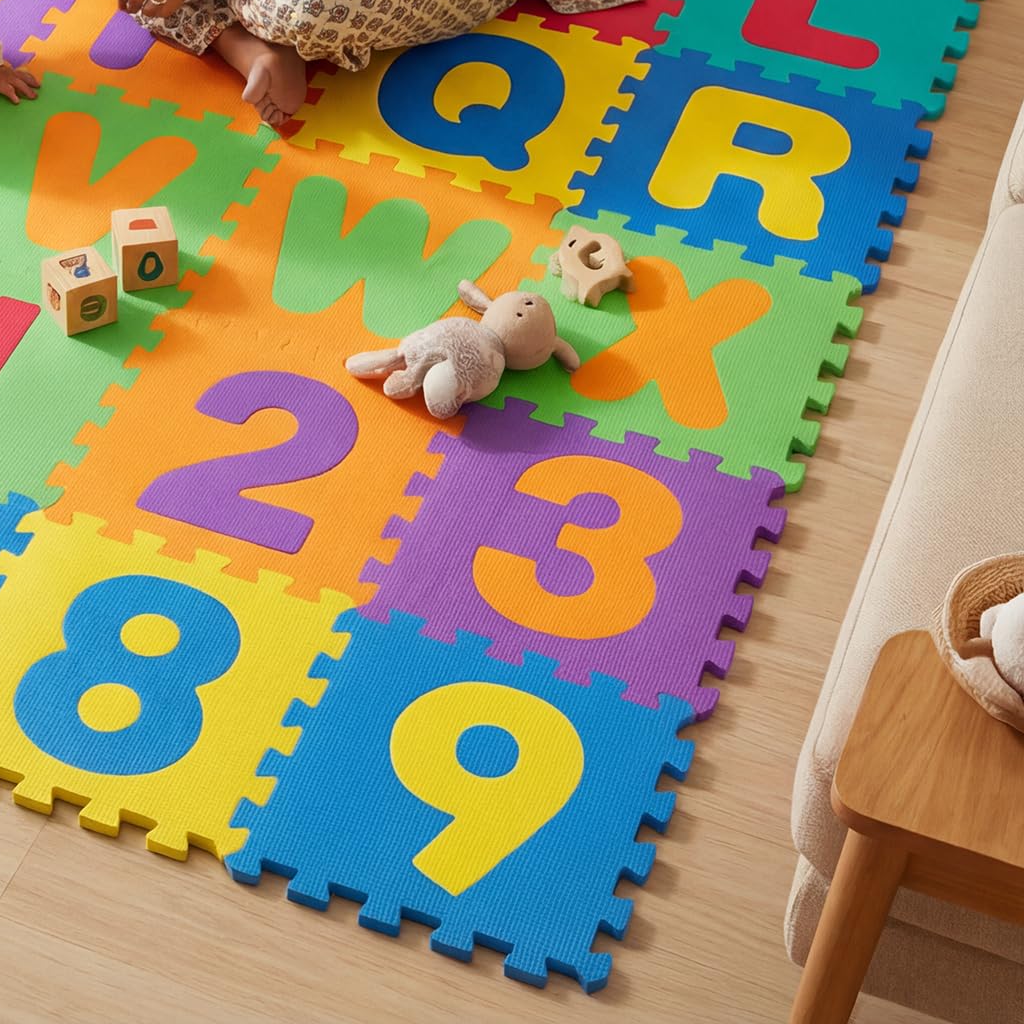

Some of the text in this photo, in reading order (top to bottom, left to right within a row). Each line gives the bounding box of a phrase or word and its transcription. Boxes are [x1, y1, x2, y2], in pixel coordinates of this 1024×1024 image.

[25, 112, 198, 252] V
[272, 175, 512, 339] W
[570, 256, 773, 430] X
[378, 33, 565, 171] Q
[648, 86, 852, 241] R
[136, 370, 360, 554] 2
[472, 455, 684, 640] 3
[13, 575, 242, 776] 8
[390, 681, 584, 896] 9
